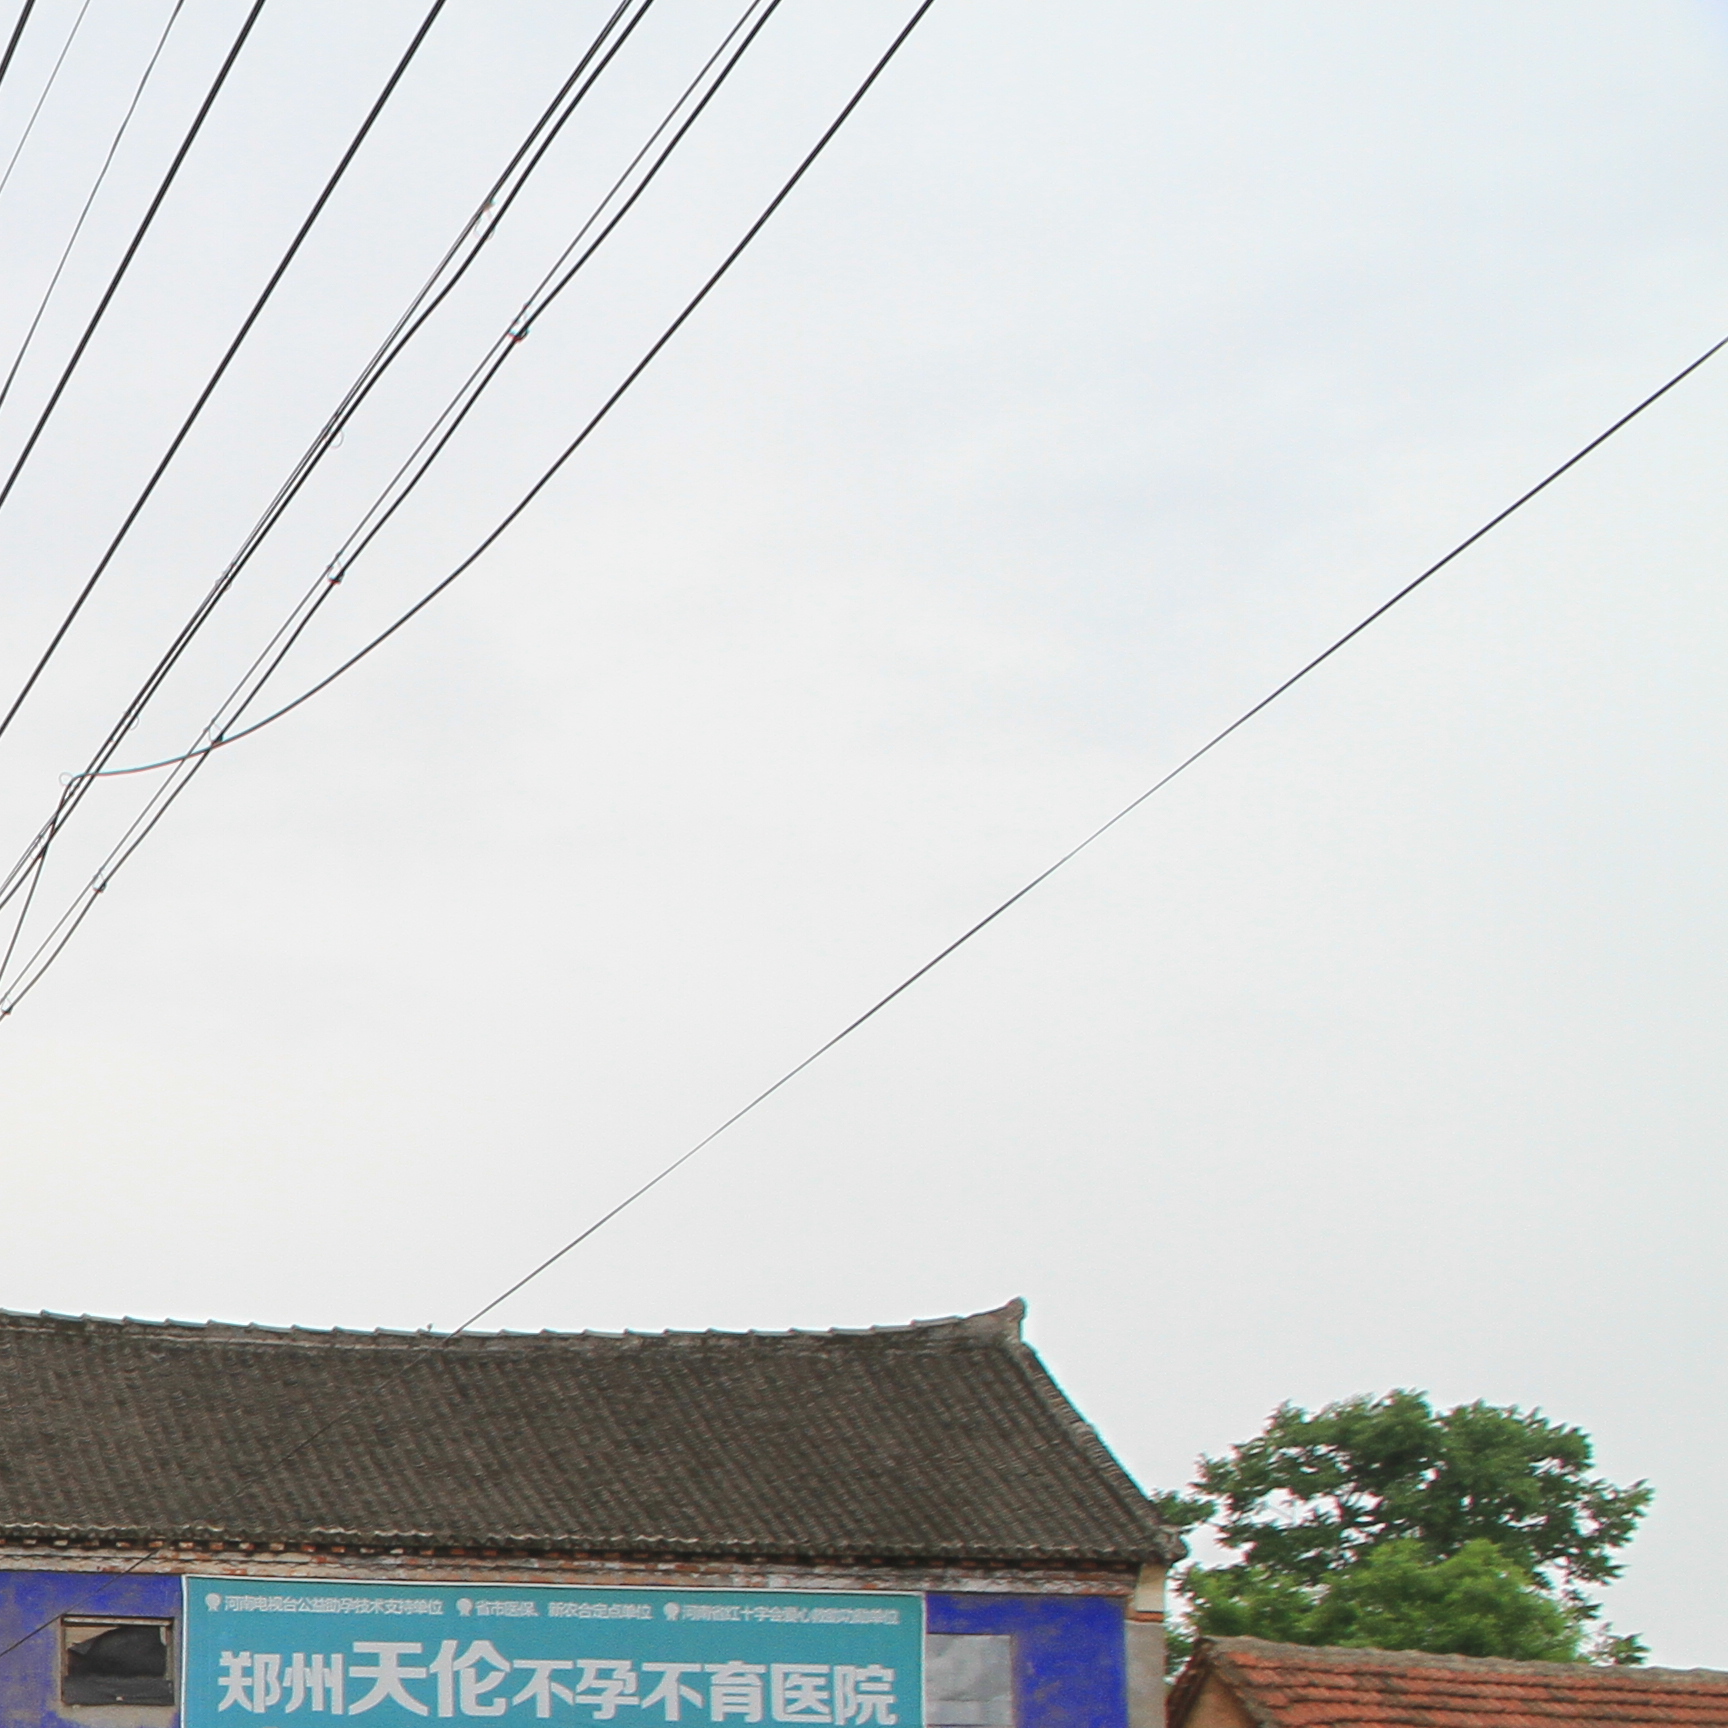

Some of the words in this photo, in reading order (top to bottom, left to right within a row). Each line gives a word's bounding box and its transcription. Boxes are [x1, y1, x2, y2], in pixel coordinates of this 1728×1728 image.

[224, 1594, 444, 1615] 河南电视台公益助孕技术支持单位
[218, 1639, 898, 1726] 郑州天伦不孕不育医院
